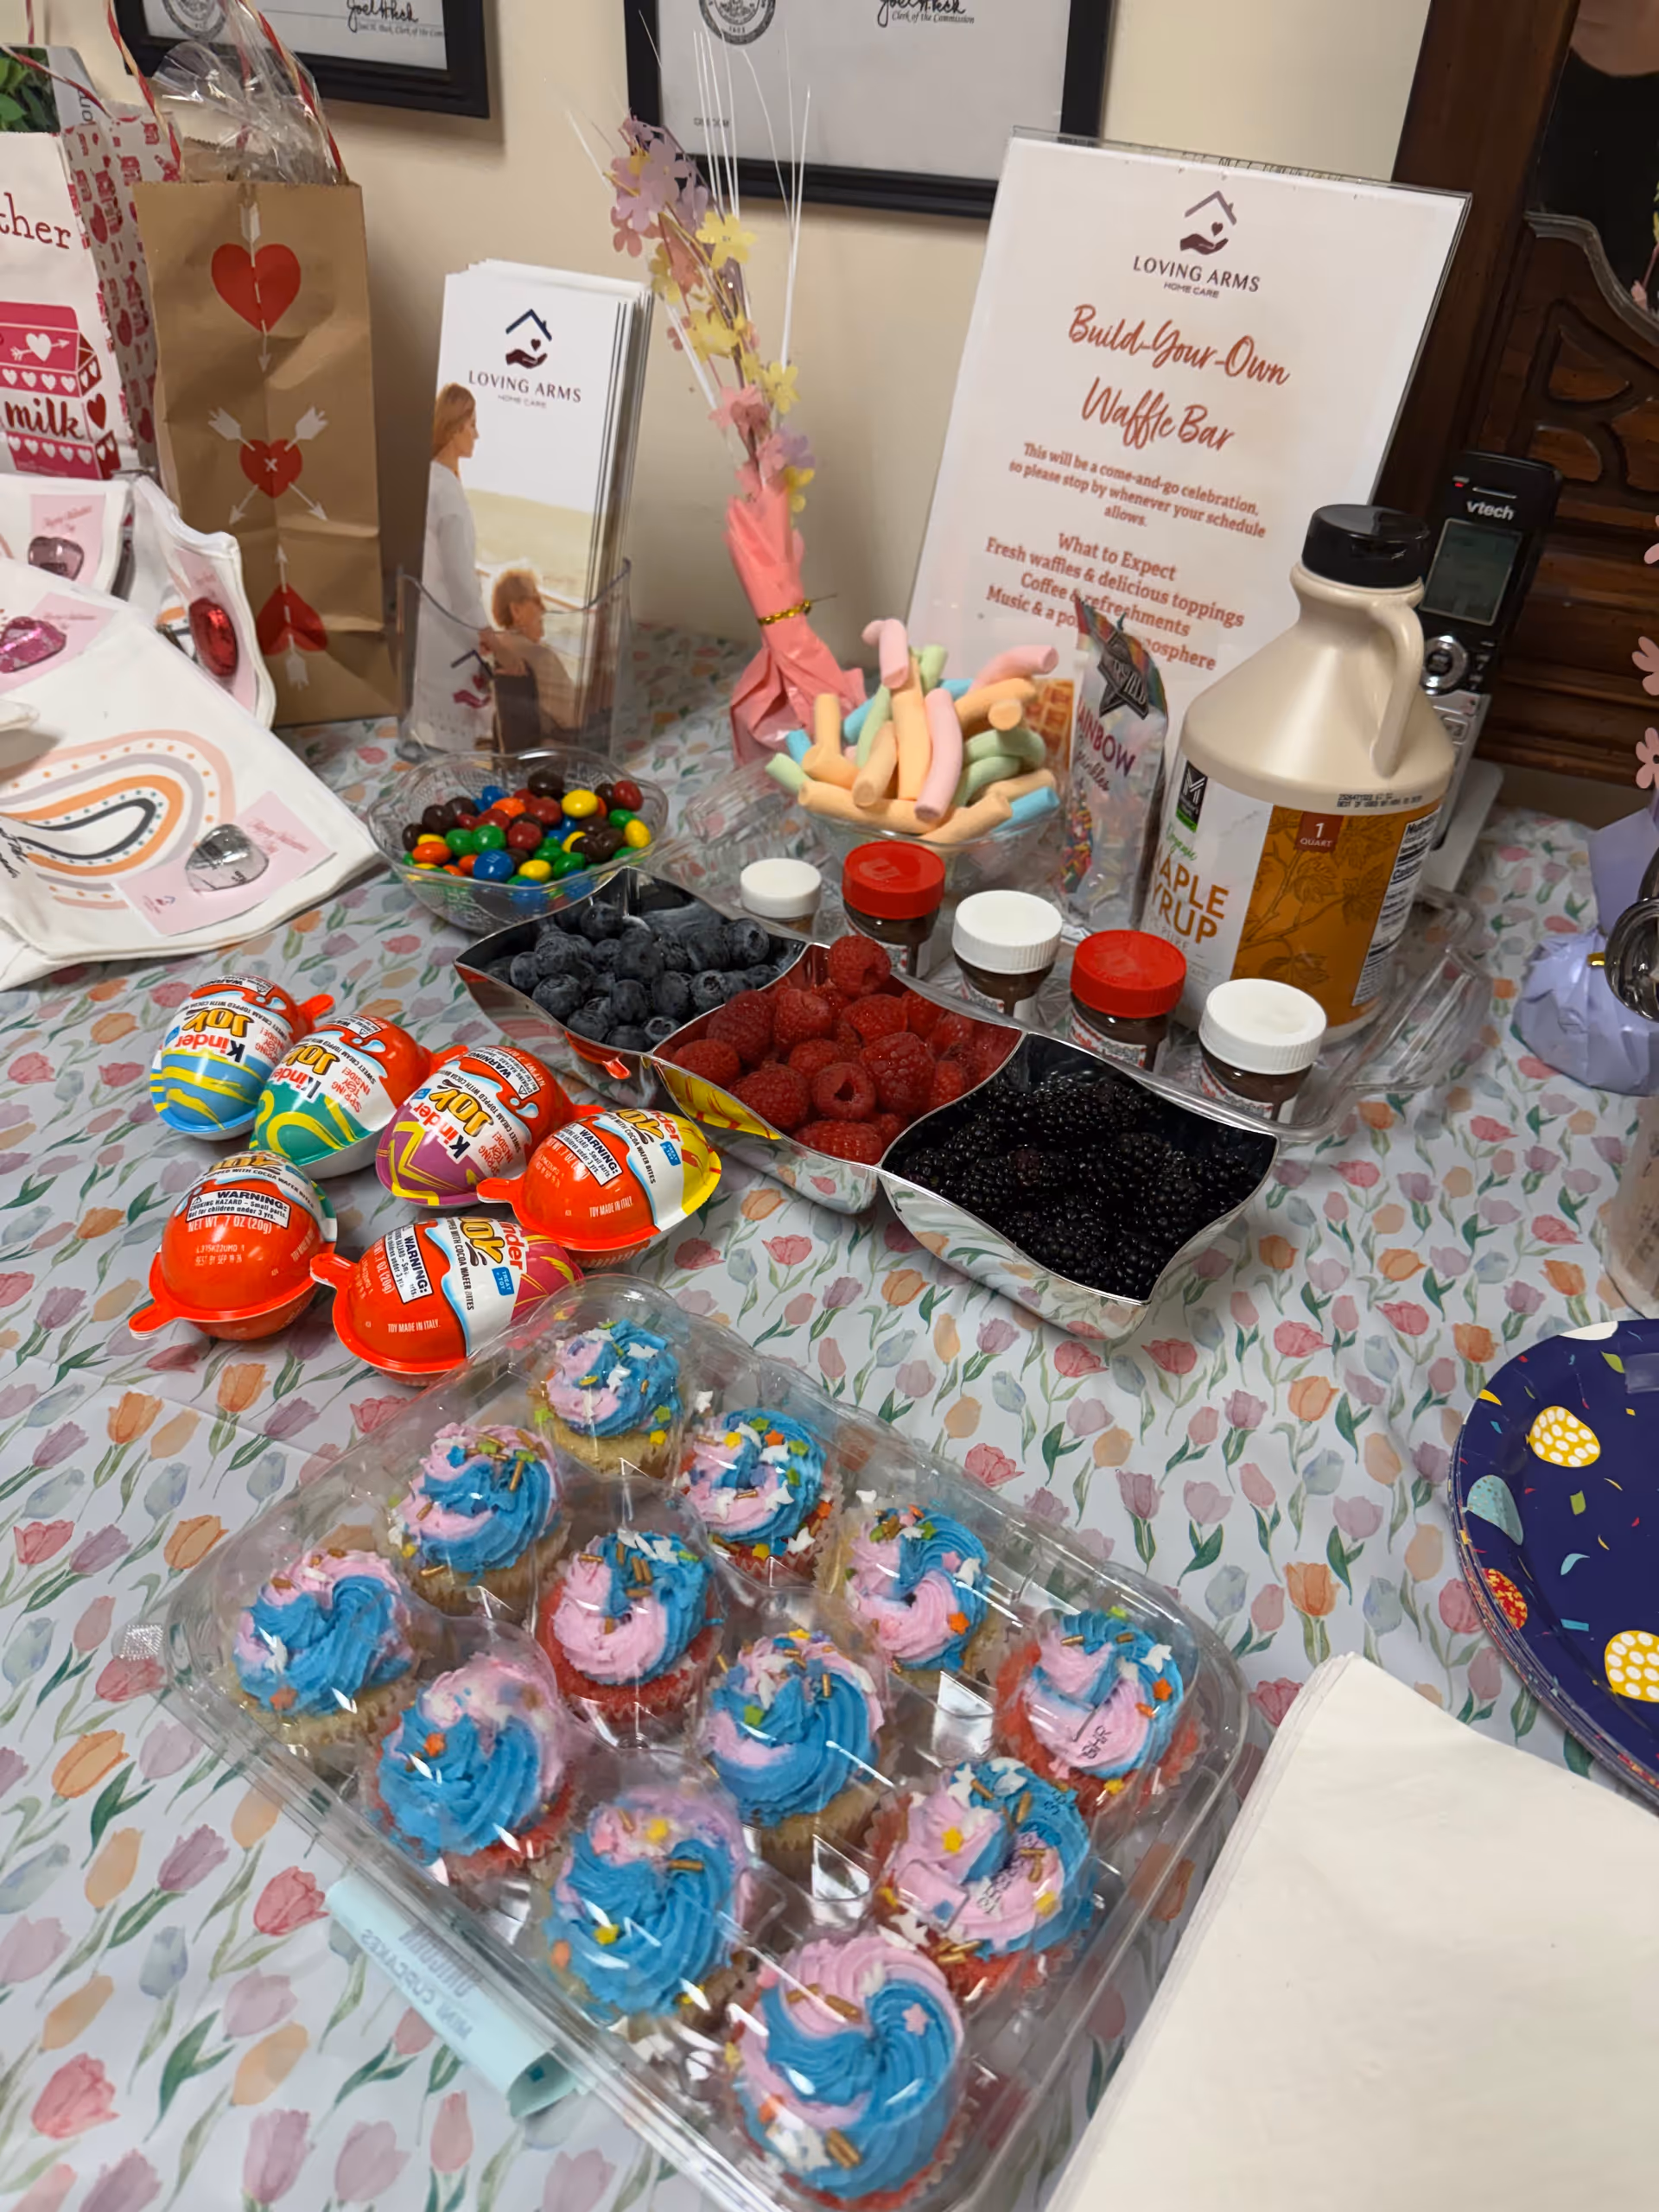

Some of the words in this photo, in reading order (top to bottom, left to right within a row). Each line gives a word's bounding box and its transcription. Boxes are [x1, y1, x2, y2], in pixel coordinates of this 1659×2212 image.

[921, 13, 932, 22] the
[933, 14, 976, 24] Commission
[1133, 256, 1203, 283] LOVING
[1206, 269, 1262, 293] ARMS
[1163, 282, 1192, 295] HOME
[1192, 287, 1220, 299] CARE
[1068, 304, 1291, 385] Build-Your-Own
[468, 370, 530, 394] LOVING
[535, 382, 582, 404] ARMS
[4, 397, 85, 440] milk
[1082, 376, 1175, 450] Waffle
[1178, 404, 1235, 450] Bar
[1024, 442, 1047, 460] This
[1049, 449, 1071, 467] will
[1073, 457, 1089, 470] be
[1090, 462, 1097, 473] a
[1099, 464, 1179, 495] come-and-go
[1008, 460, 1023, 474] so
[1023, 464, 1061, 483] please
[1063, 474, 1090, 493] stop
[1091, 480, 1107, 499] by
[1109, 486, 1172, 513] whenever
[1173, 502, 1205, 522] your
[1205, 509, 1267, 538] schedule
[1466, 500, 1515, 521] vtech
[1104, 504, 1148, 528] allows.
[1058, 533, 1098, 559] What
[1102, 546, 1119, 565] to
[1121, 551, 1177, 582] Expect
[985, 537, 1027, 562] Fresh
[1030, 552, 1082, 580] waffles
[1083, 568, 1095, 583] &
[1098, 573, 1169, 605] delicious
[1172, 594, 1245, 629] toppings
[985, 585, 1027, 613] Music
[1031, 601, 1043, 616] &
[1046, 608, 1056, 620] a
[1020, 572, 1068, 600] Coffee
[1084, 593, 1192, 638] refreshments
[1315, 823, 1325, 839] 1
[1300, 838, 1332, 848] QUART
[1154, 878, 1217, 944] YRUP
[182, 1007, 255, 1038] JOY
[175, 1033, 245, 1063] Kinder
[322, 1039, 343, 1053] TOPPED
[341, 1051, 359, 1066] CREAM
[271, 1068, 322, 1100] Kinde
[342, 1066, 372, 1096] INSIDE!
[358, 1065, 377, 1084] SWEET
[450, 1072, 467, 1086] COCOA
[331, 1081, 362, 1113] SPRING
[342, 1078, 361, 1098] TOY
[464, 1082, 480, 1096] WITH
[429, 1088, 495, 1138] JOY
[478, 1093, 499, 1116] TOPPED
[414, 1103, 471, 1160] Kinder
[495, 1112, 512, 1133] CREAM
[489, 1144, 507, 1164] TOY
[492, 1131, 515, 1164] INSIDE!
[576, 1147, 589, 1161] under
[579, 1129, 619, 1174] WARNING:
[625, 1128, 639, 1147] COCOA
[636, 1145, 650, 1166] WAFER
[645, 1164, 657, 1185] BITES
[478, 1145, 501, 1177] SPRING
[588, 1150, 602, 1165] Small
[598, 1163, 611, 1179] parts.
[253, 1169, 277, 1180] COCOA
[277, 1178, 300, 1192] WAFER
[189, 1200, 214, 1211] CHOKING
[250, 1200, 269, 1211] Small
[270, 1206, 289, 1220] parts.
[217, 1190, 288, 1212] WARNING:
[589, 1206, 601, 1218] TOY
[599, 1203, 615, 1216] MADE
[614, 1200, 621, 1211] IN
[188, 1211, 198, 1219] Not
[207, 1205, 235, 1213] children
[236, 1205, 257, 1214] under
[257, 1208, 263, 1217] 3
[264, 1212, 276, 1221] yrs.
[188, 1217, 203, 1233] NET
[232, 1216, 245, 1228] OZ
[247, 1217, 272, 1235] (20g)
[451, 1230, 462, 1247] WITH
[217, 1255, 228, 1265] SEP
[391, 1256, 399, 1273] under
[404, 1235, 428, 1294] WARNING:
[454, 1244, 466, 1268] COCOA
[376, 1262, 388, 1274] OZ
[460, 1266, 472, 1291] WAFER
[378, 1271, 396, 1294] (20g)
[498, 1277, 506, 1290] TOY
[501, 1270, 512, 1291] TREAT
[464, 1289, 475, 1311] BITES
[388, 1323, 398, 1333] TOY
[398, 1321, 416, 1332] MADE
[416, 1321, 423, 1331] IN
[423, 1319, 442, 1330] ITALY.
